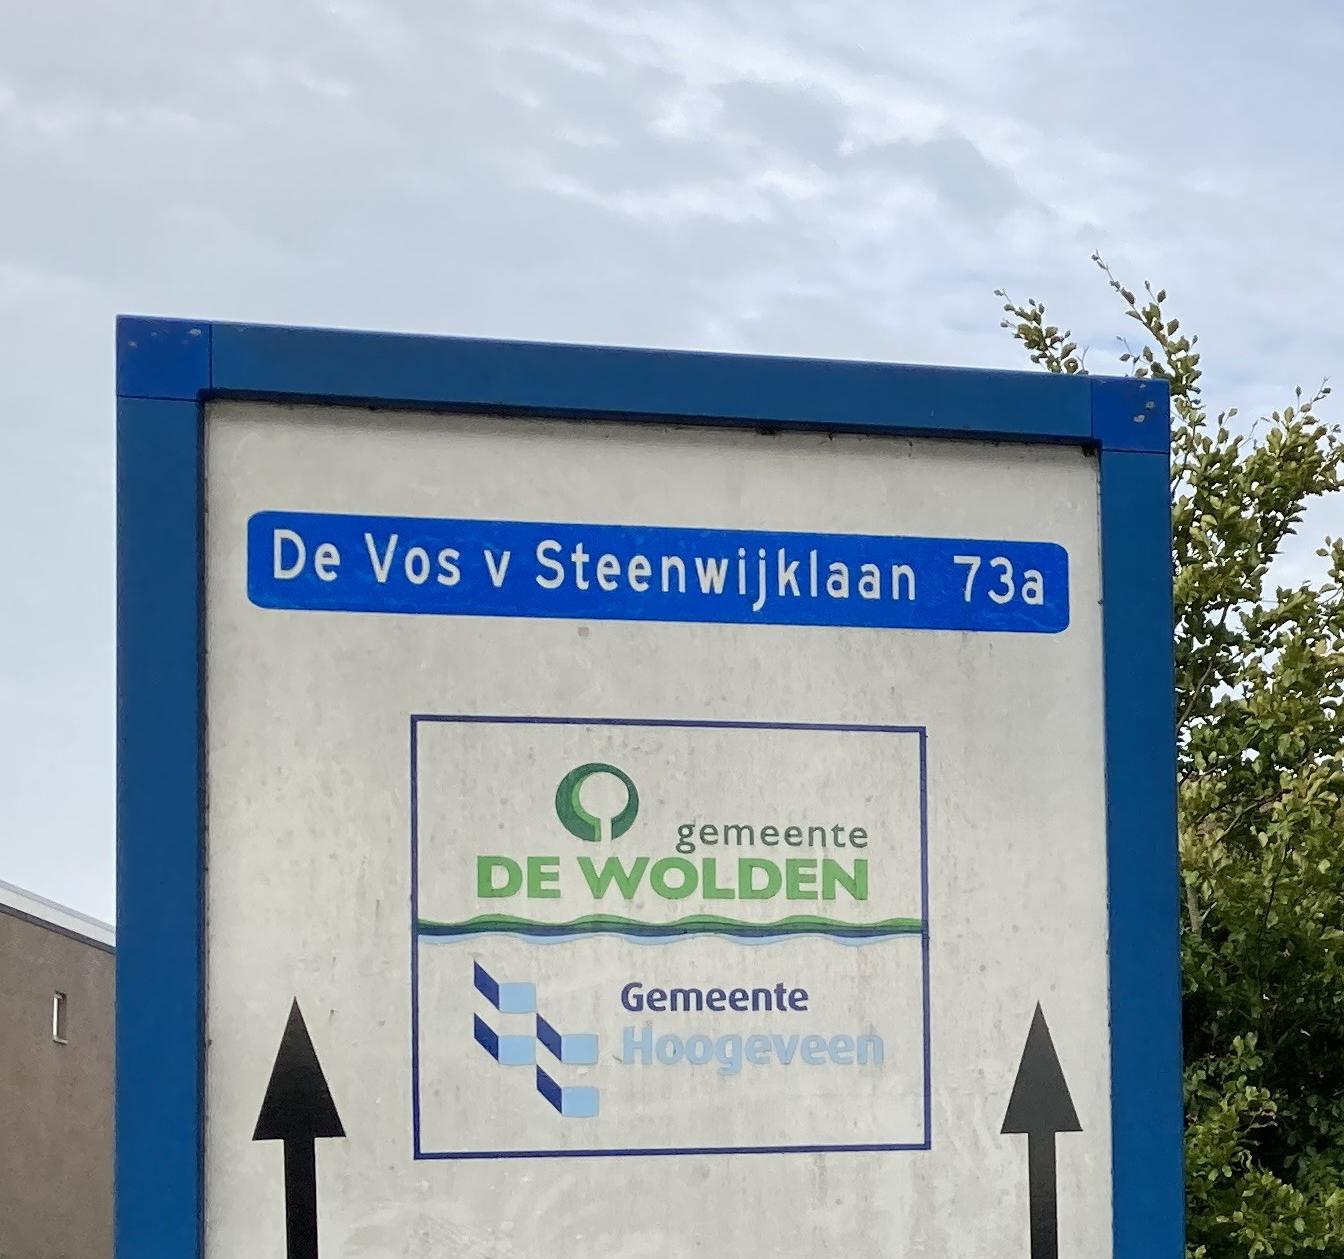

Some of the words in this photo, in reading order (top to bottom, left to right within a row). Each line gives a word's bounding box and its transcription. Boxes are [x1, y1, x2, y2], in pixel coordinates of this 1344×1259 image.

[273, 529, 341, 582] De
[364, 532, 461, 586] Vos
[483, 550, 511, 588] v
[536, 539, 917, 612] Steenwijklaan
[953, 555, 1044, 606] 73a
[675, 822, 868, 854] gemeente
[477, 855, 561, 898] DE
[577, 856, 869, 900] WOLDEN
[621, 982, 809, 1012] Gemeente
[622, 1025, 884, 1076] Hoogeveen
